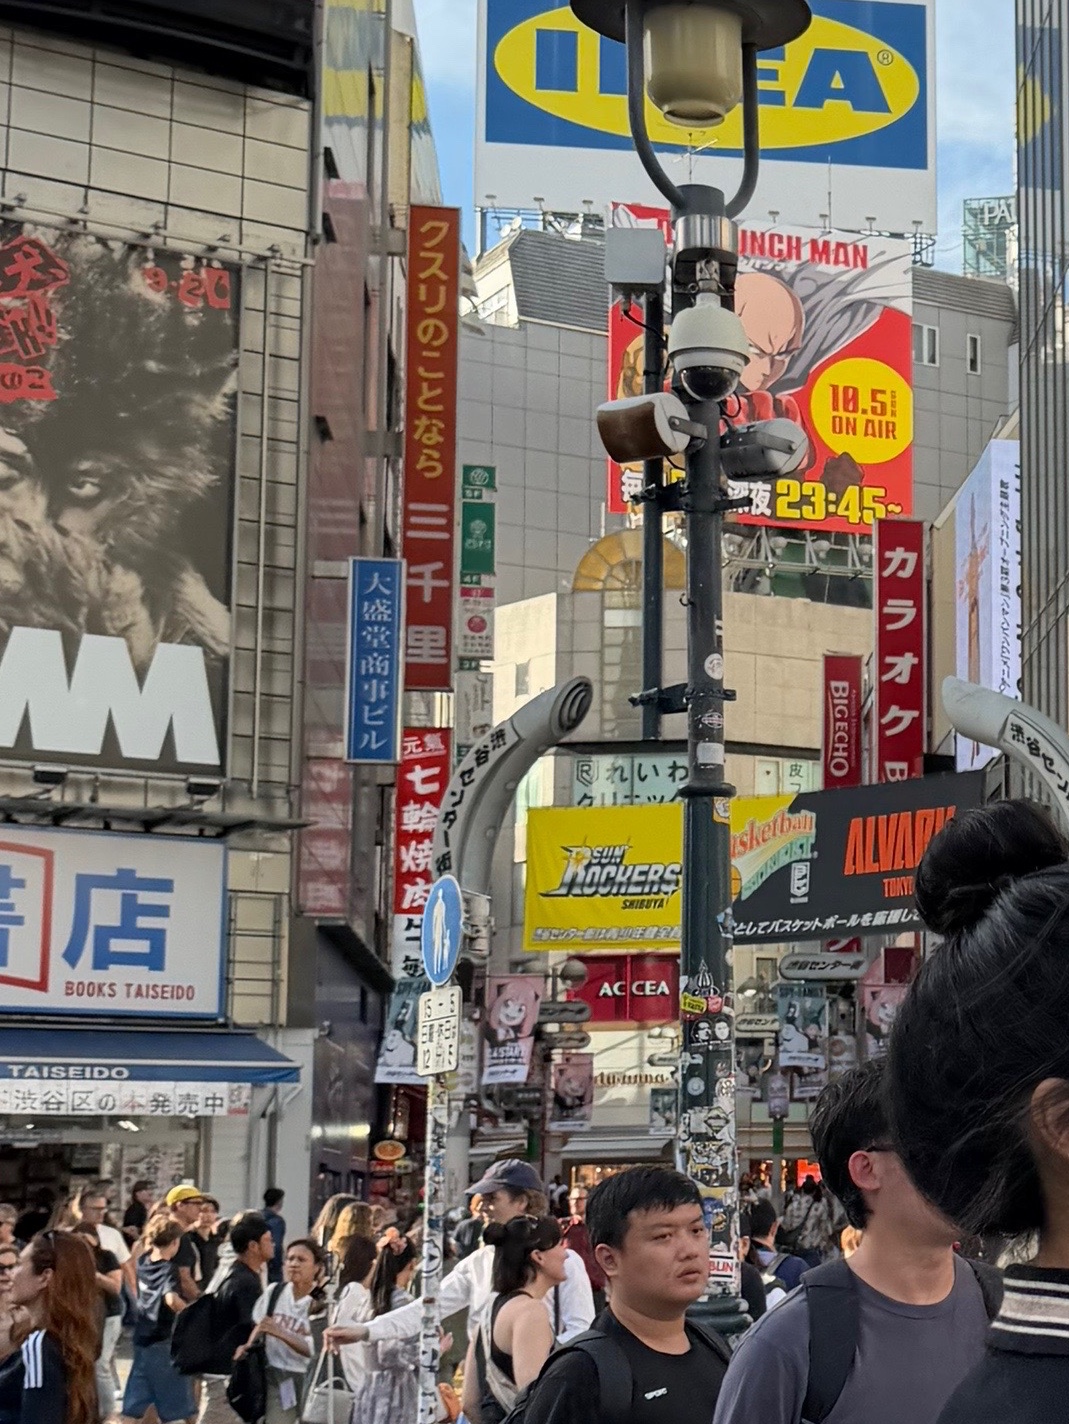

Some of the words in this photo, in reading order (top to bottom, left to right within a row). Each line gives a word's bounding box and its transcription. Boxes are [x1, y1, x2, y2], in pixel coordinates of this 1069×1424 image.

[738, 228, 802, 262] NCH
[808, 238, 869, 270] MAN
[413, 220, 450, 479] クスリのことなら
[829, 383, 887, 418] 10.5
[832, 415, 858, 437] ON
[863, 418, 898, 440] AIR
[405, 502, 451, 665] 三千里
[359, 571, 394, 751] 大盛堂商事ビル
[881, 546, 920, 738] カラオケ
[830, 680, 850, 723] BIG
[830, 723, 850, 777] ECHO
[606, 759, 689, 784] れいわ
[434, 727, 507, 876] 渋谷センター街
[540, 846, 682, 898] ROCKERS
[591, 844, 626, 865] SUN
[621, 898, 664, 910] SHIBUYA
[882, 875, 914, 898] TOKY
[64, 980, 117, 999] BOOKS
[125, 981, 195, 1001] TAISEIDO
[599, 980, 670, 997] ACCEA
[8, 1064, 131, 1080] TAISEIDO
